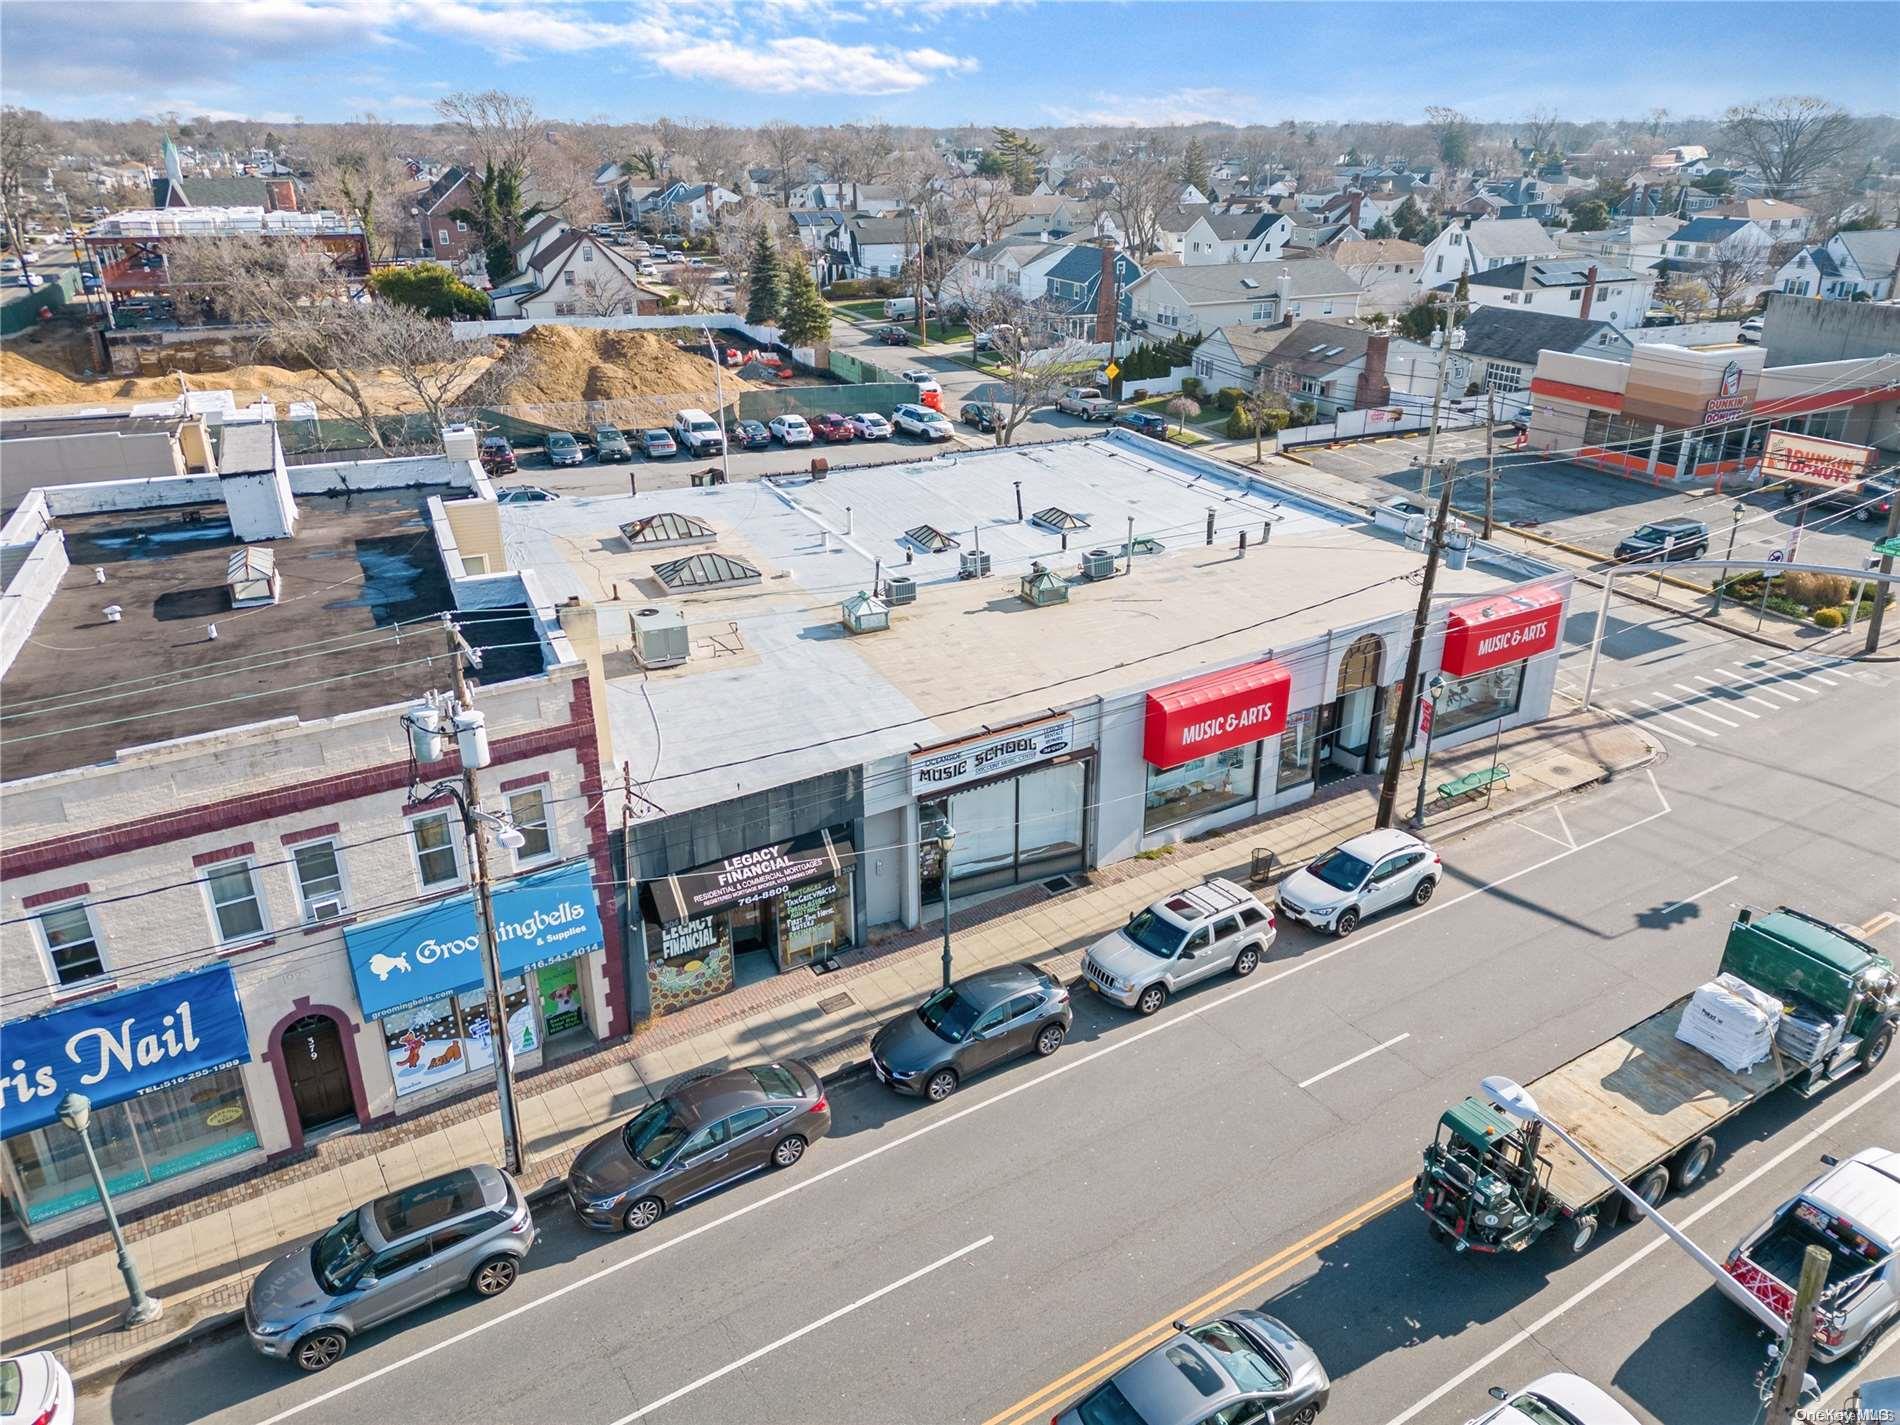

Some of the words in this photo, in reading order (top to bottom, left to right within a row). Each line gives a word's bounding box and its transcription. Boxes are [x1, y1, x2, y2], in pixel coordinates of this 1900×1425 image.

[1478, 633, 1510, 657] MUSIC
[1511, 630, 1521, 647] &
[1522, 621, 1548, 643] ARTS
[1182, 714, 1225, 746] MUSIC
[1226, 711, 1238, 732] &
[1239, 702, 1272, 728] ARTS
[919, 760, 968, 783] MUSIC
[974, 738, 1038, 767] SCHOOL
[718, 856, 793, 886] FINANCIAL
[723, 846, 779, 872] LEGACY
[693, 882, 736, 903] RESIDENTIAL
[742, 870, 783, 888] COMMERCIAL
[784, 859, 823, 877] MORTGAGES
[737, 885, 789, 906] 764-8800
[416, 901, 585, 964] Grooingbells
[536, 936, 545, 947] &
[546, 925, 587, 943] Supplies
[662, 915, 713, 941] LEGACY
[662, 927, 717, 959] FINANCIAL
[524, 943, 599, 972] 516.543.4014
[371, 989, 454, 1020] groomingbells.com
[65, 1001, 200, 1085] Nail
[306, 1036, 318, 1061] 379
